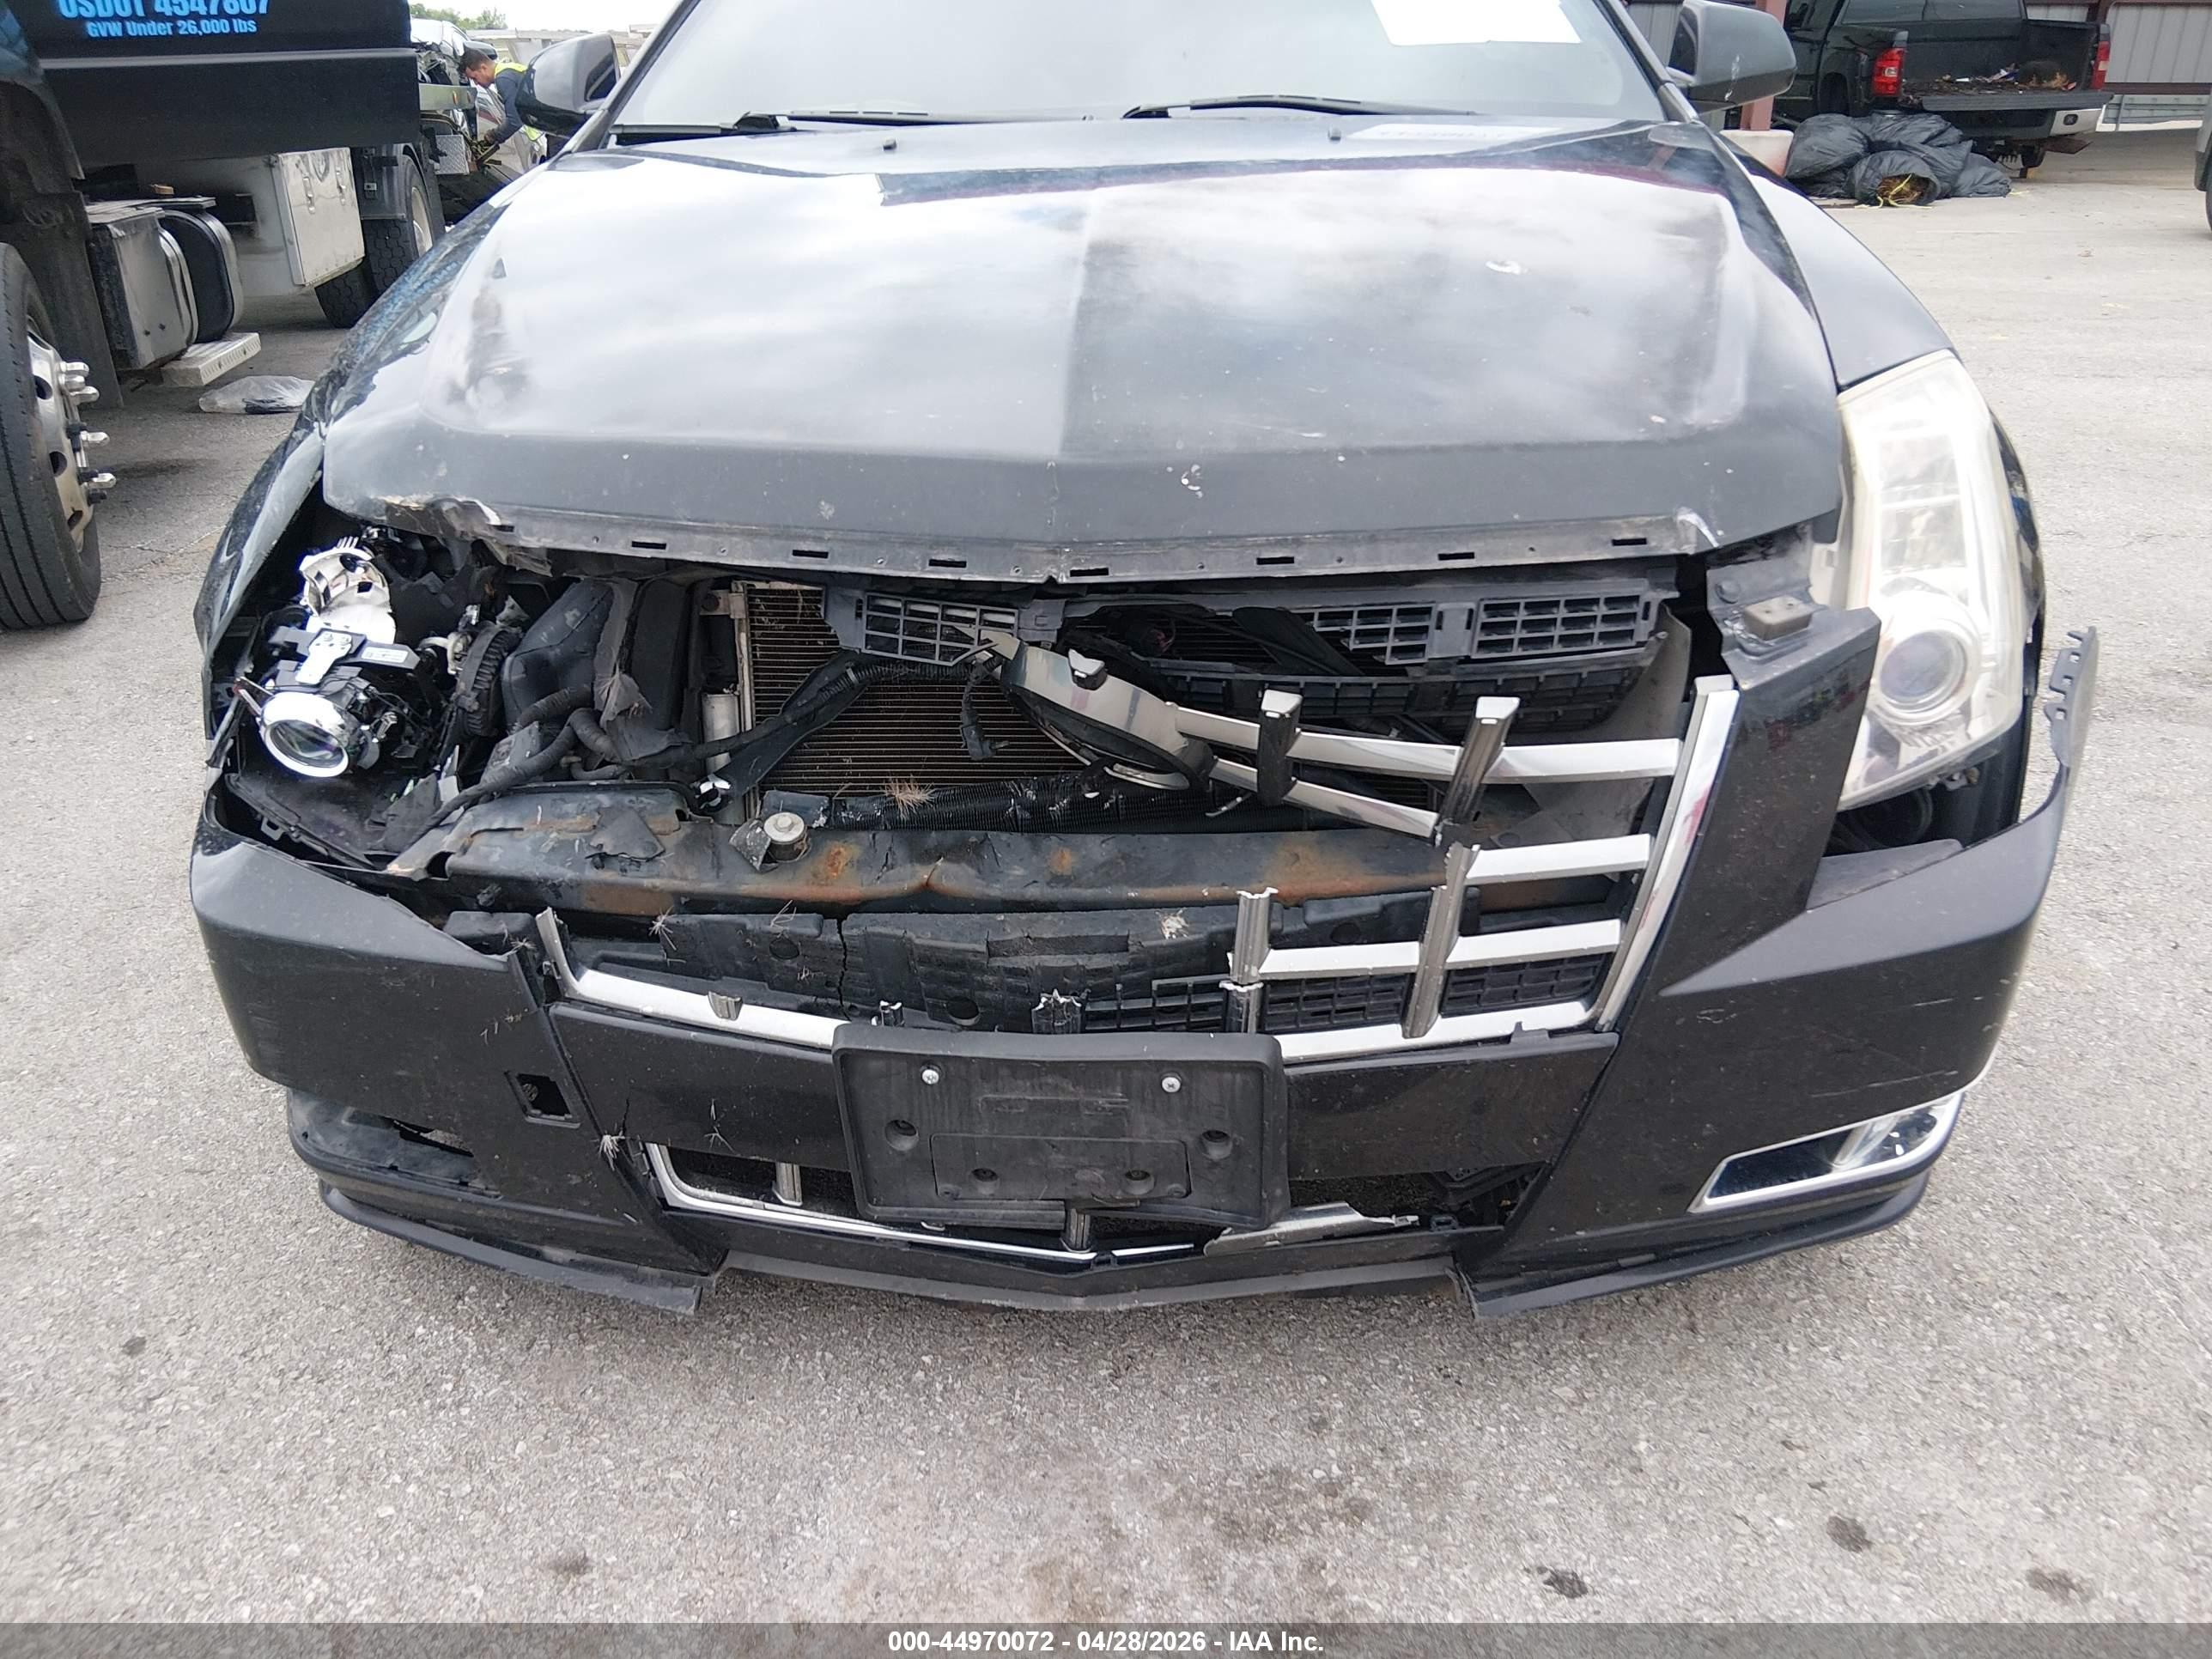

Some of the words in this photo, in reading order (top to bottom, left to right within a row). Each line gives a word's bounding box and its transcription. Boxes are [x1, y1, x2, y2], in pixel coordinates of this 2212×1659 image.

[58, 0, 145, 18] USDOT
[87, 21, 123, 37] GVW
[125, 20, 173, 36] Under
[177, 19, 230, 36] 26,000
[233, 18, 257, 33] lbs
